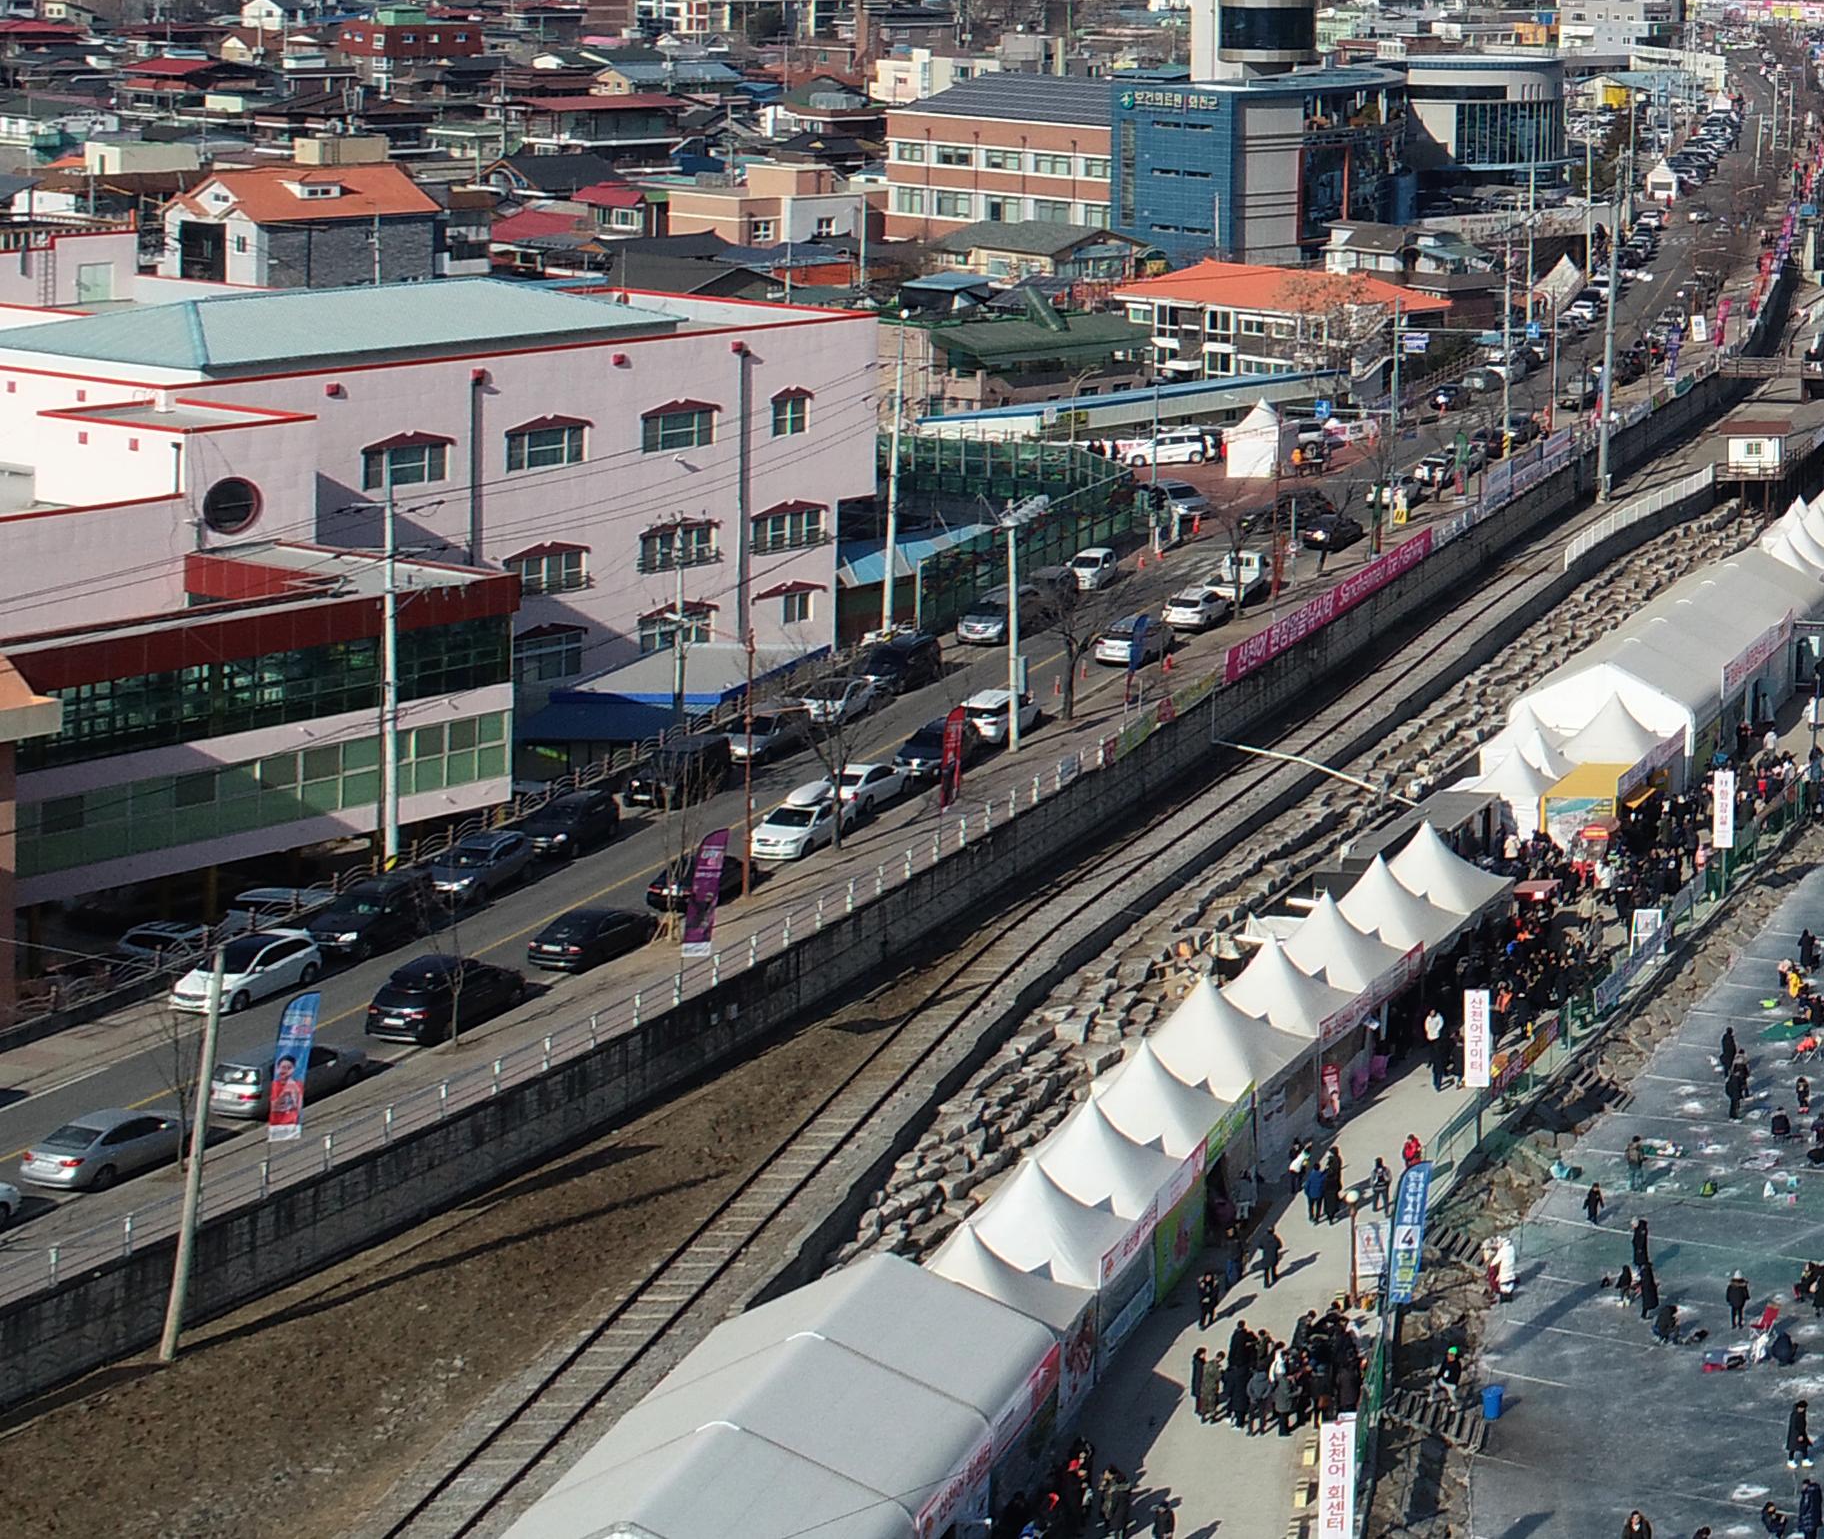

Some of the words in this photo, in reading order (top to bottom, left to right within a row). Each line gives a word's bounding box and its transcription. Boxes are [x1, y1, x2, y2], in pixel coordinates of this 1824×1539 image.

[1401, 1227, 1413, 1246] 4
[1329, 1430, 1348, 1478] 산천어
[1326, 1483, 1346, 1532] 회센터
